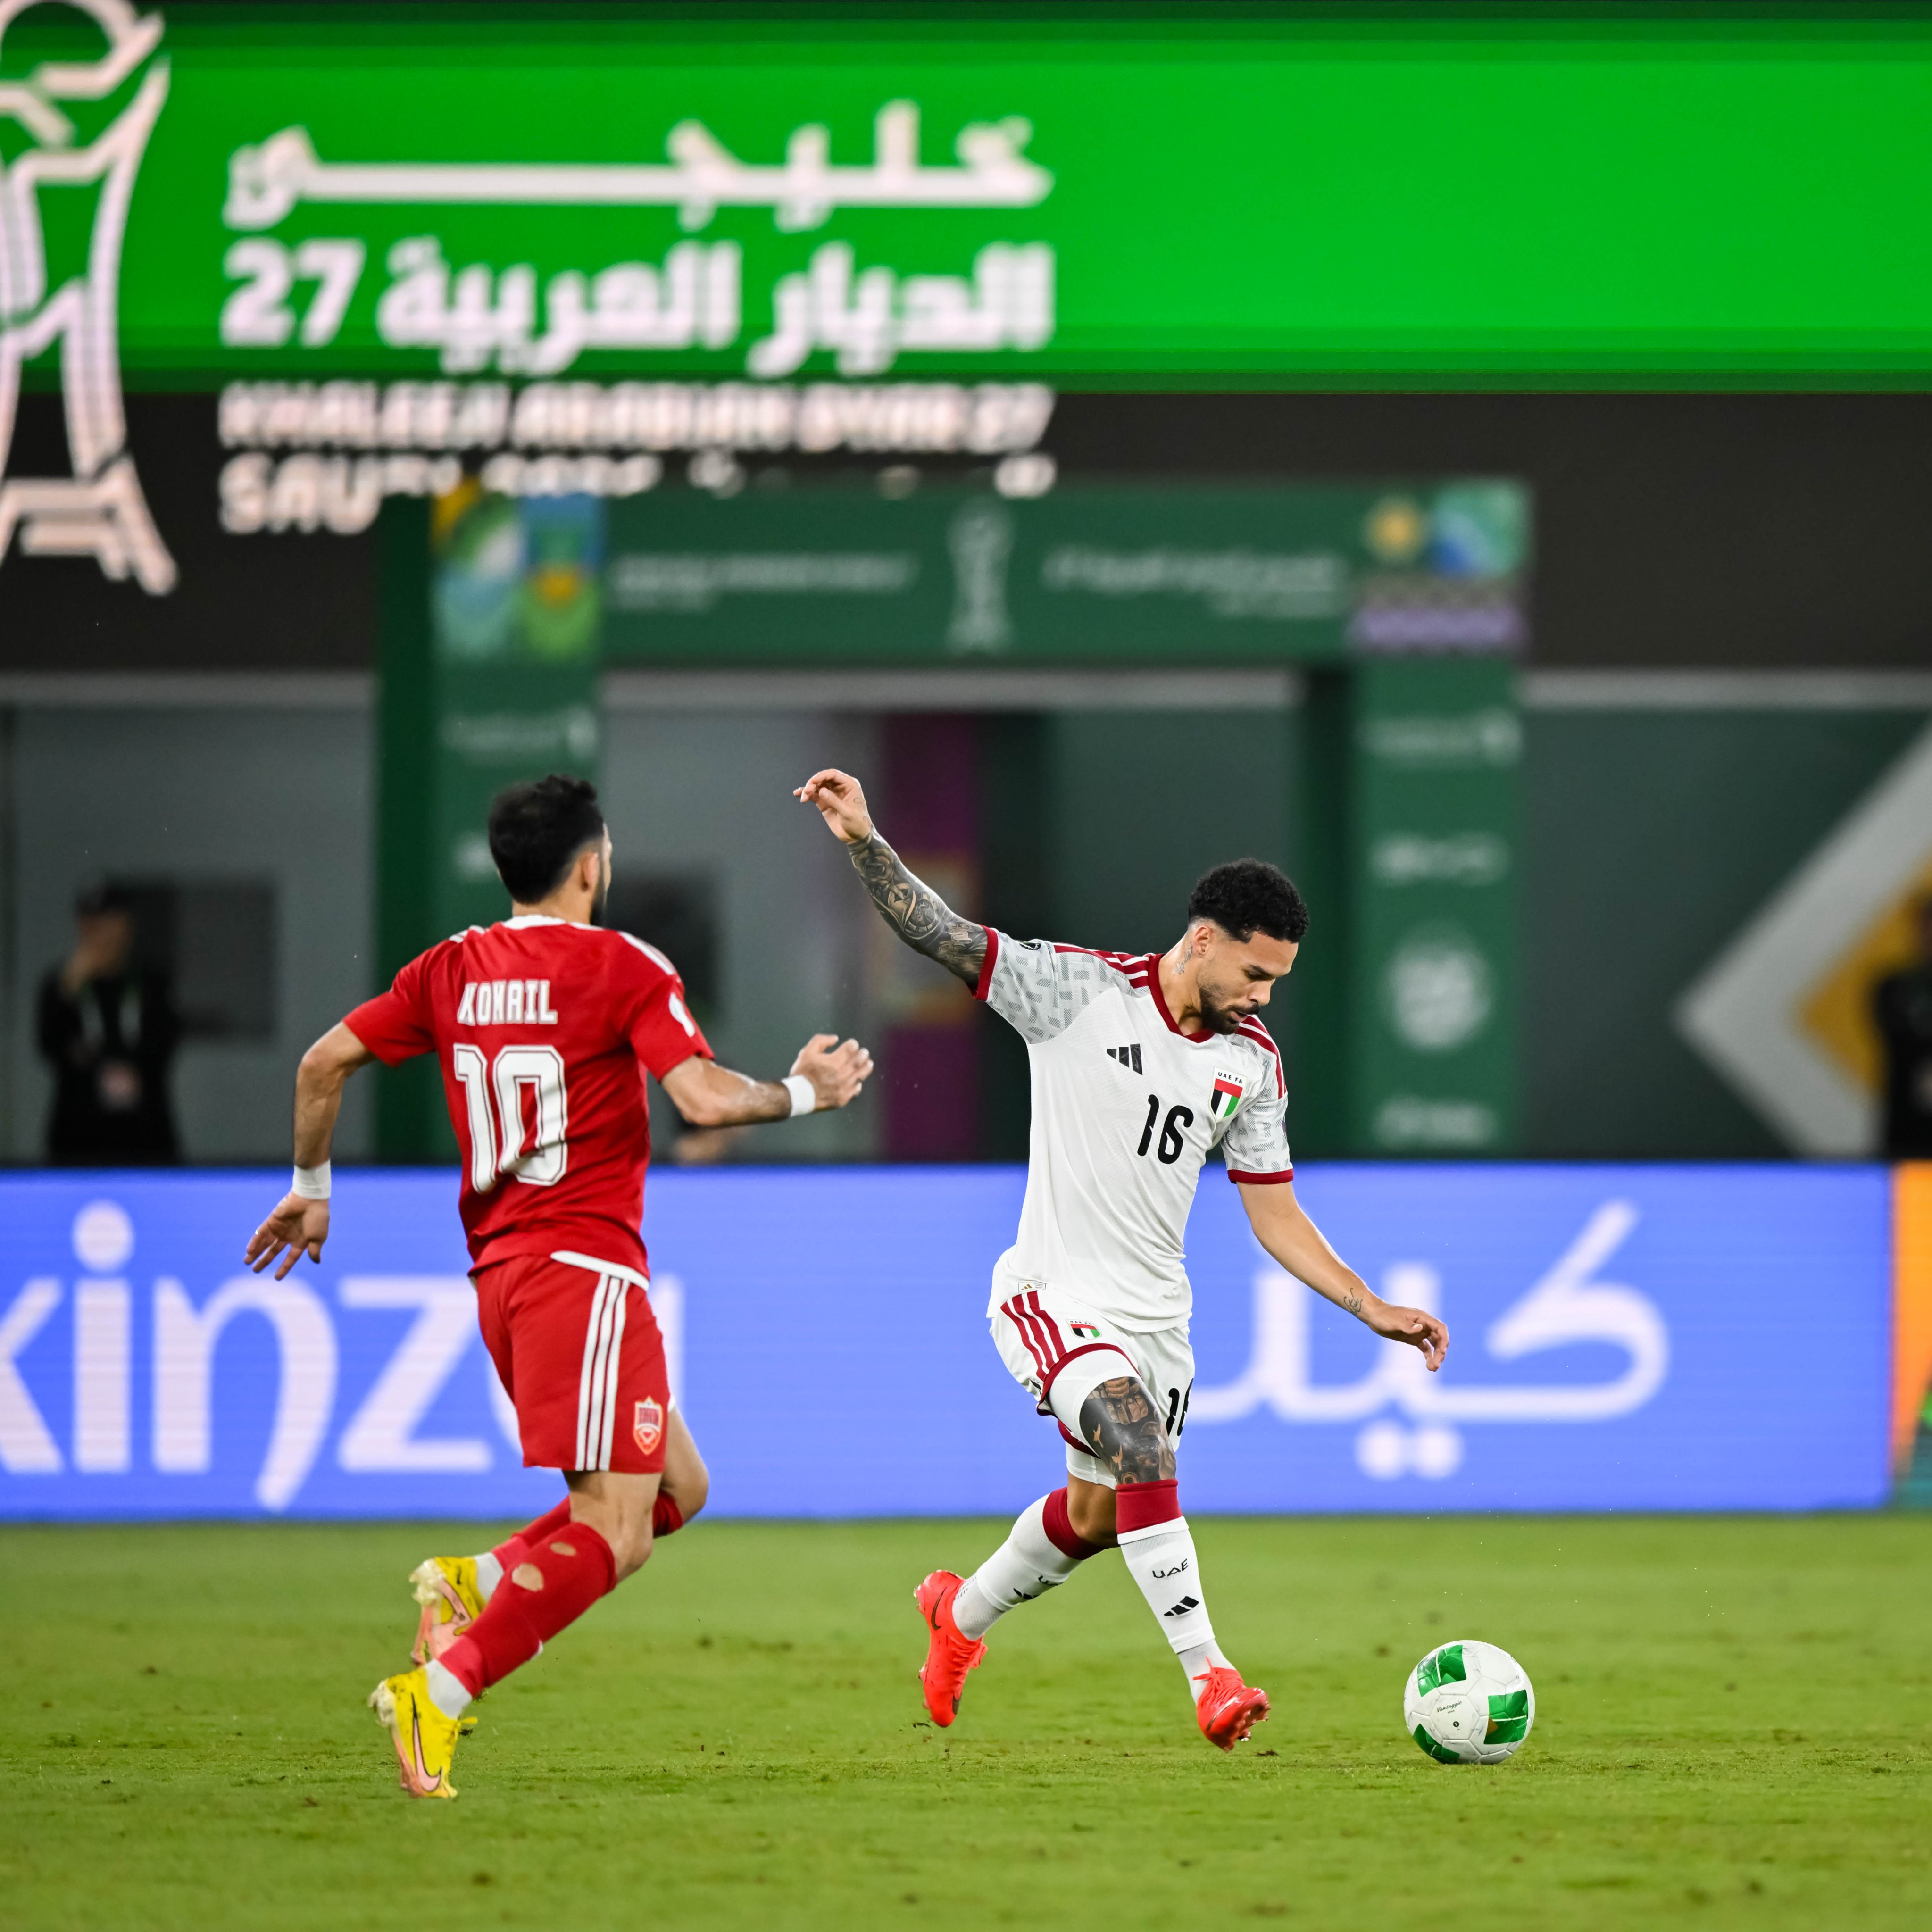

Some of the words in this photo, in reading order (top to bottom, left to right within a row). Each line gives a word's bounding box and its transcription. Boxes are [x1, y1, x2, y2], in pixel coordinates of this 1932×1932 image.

[221, 238, 367, 347] 27
[1218, 1072, 1232, 1080] UAE
[453, 1043, 568, 1195] 10
[1137, 1094, 1194, 1164] 16
[1152, 1558, 1189, 1579] UAE
